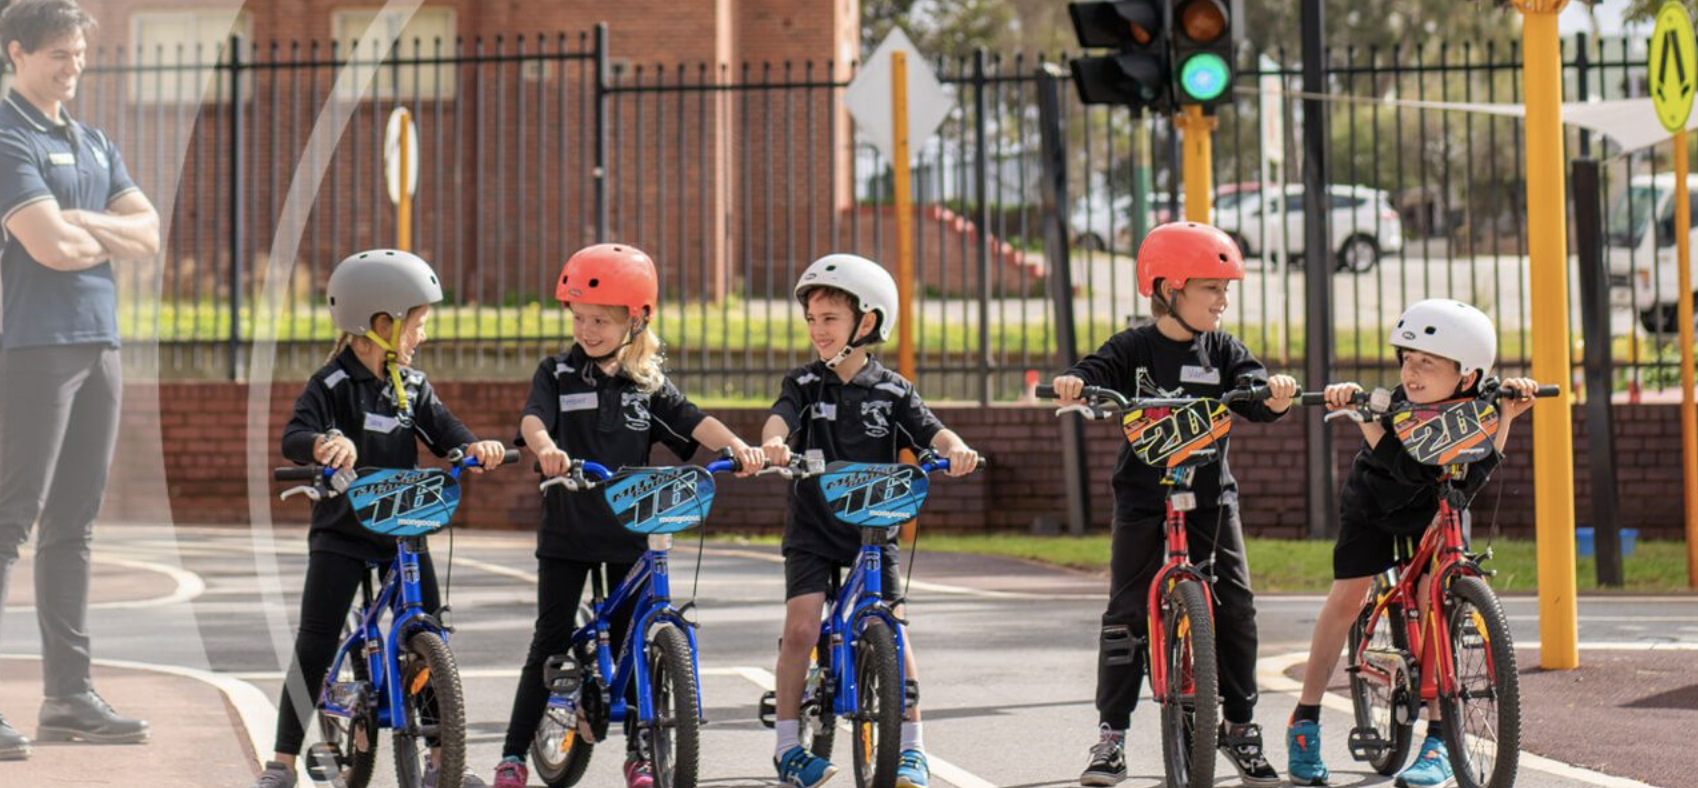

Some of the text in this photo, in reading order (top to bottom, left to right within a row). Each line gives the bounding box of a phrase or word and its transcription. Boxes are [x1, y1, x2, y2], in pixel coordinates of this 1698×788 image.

[1141, 398, 1213, 465] 20
[369, 475, 444, 526] 16
[628, 470, 698, 527] 16
[841, 469, 913, 517] 16
